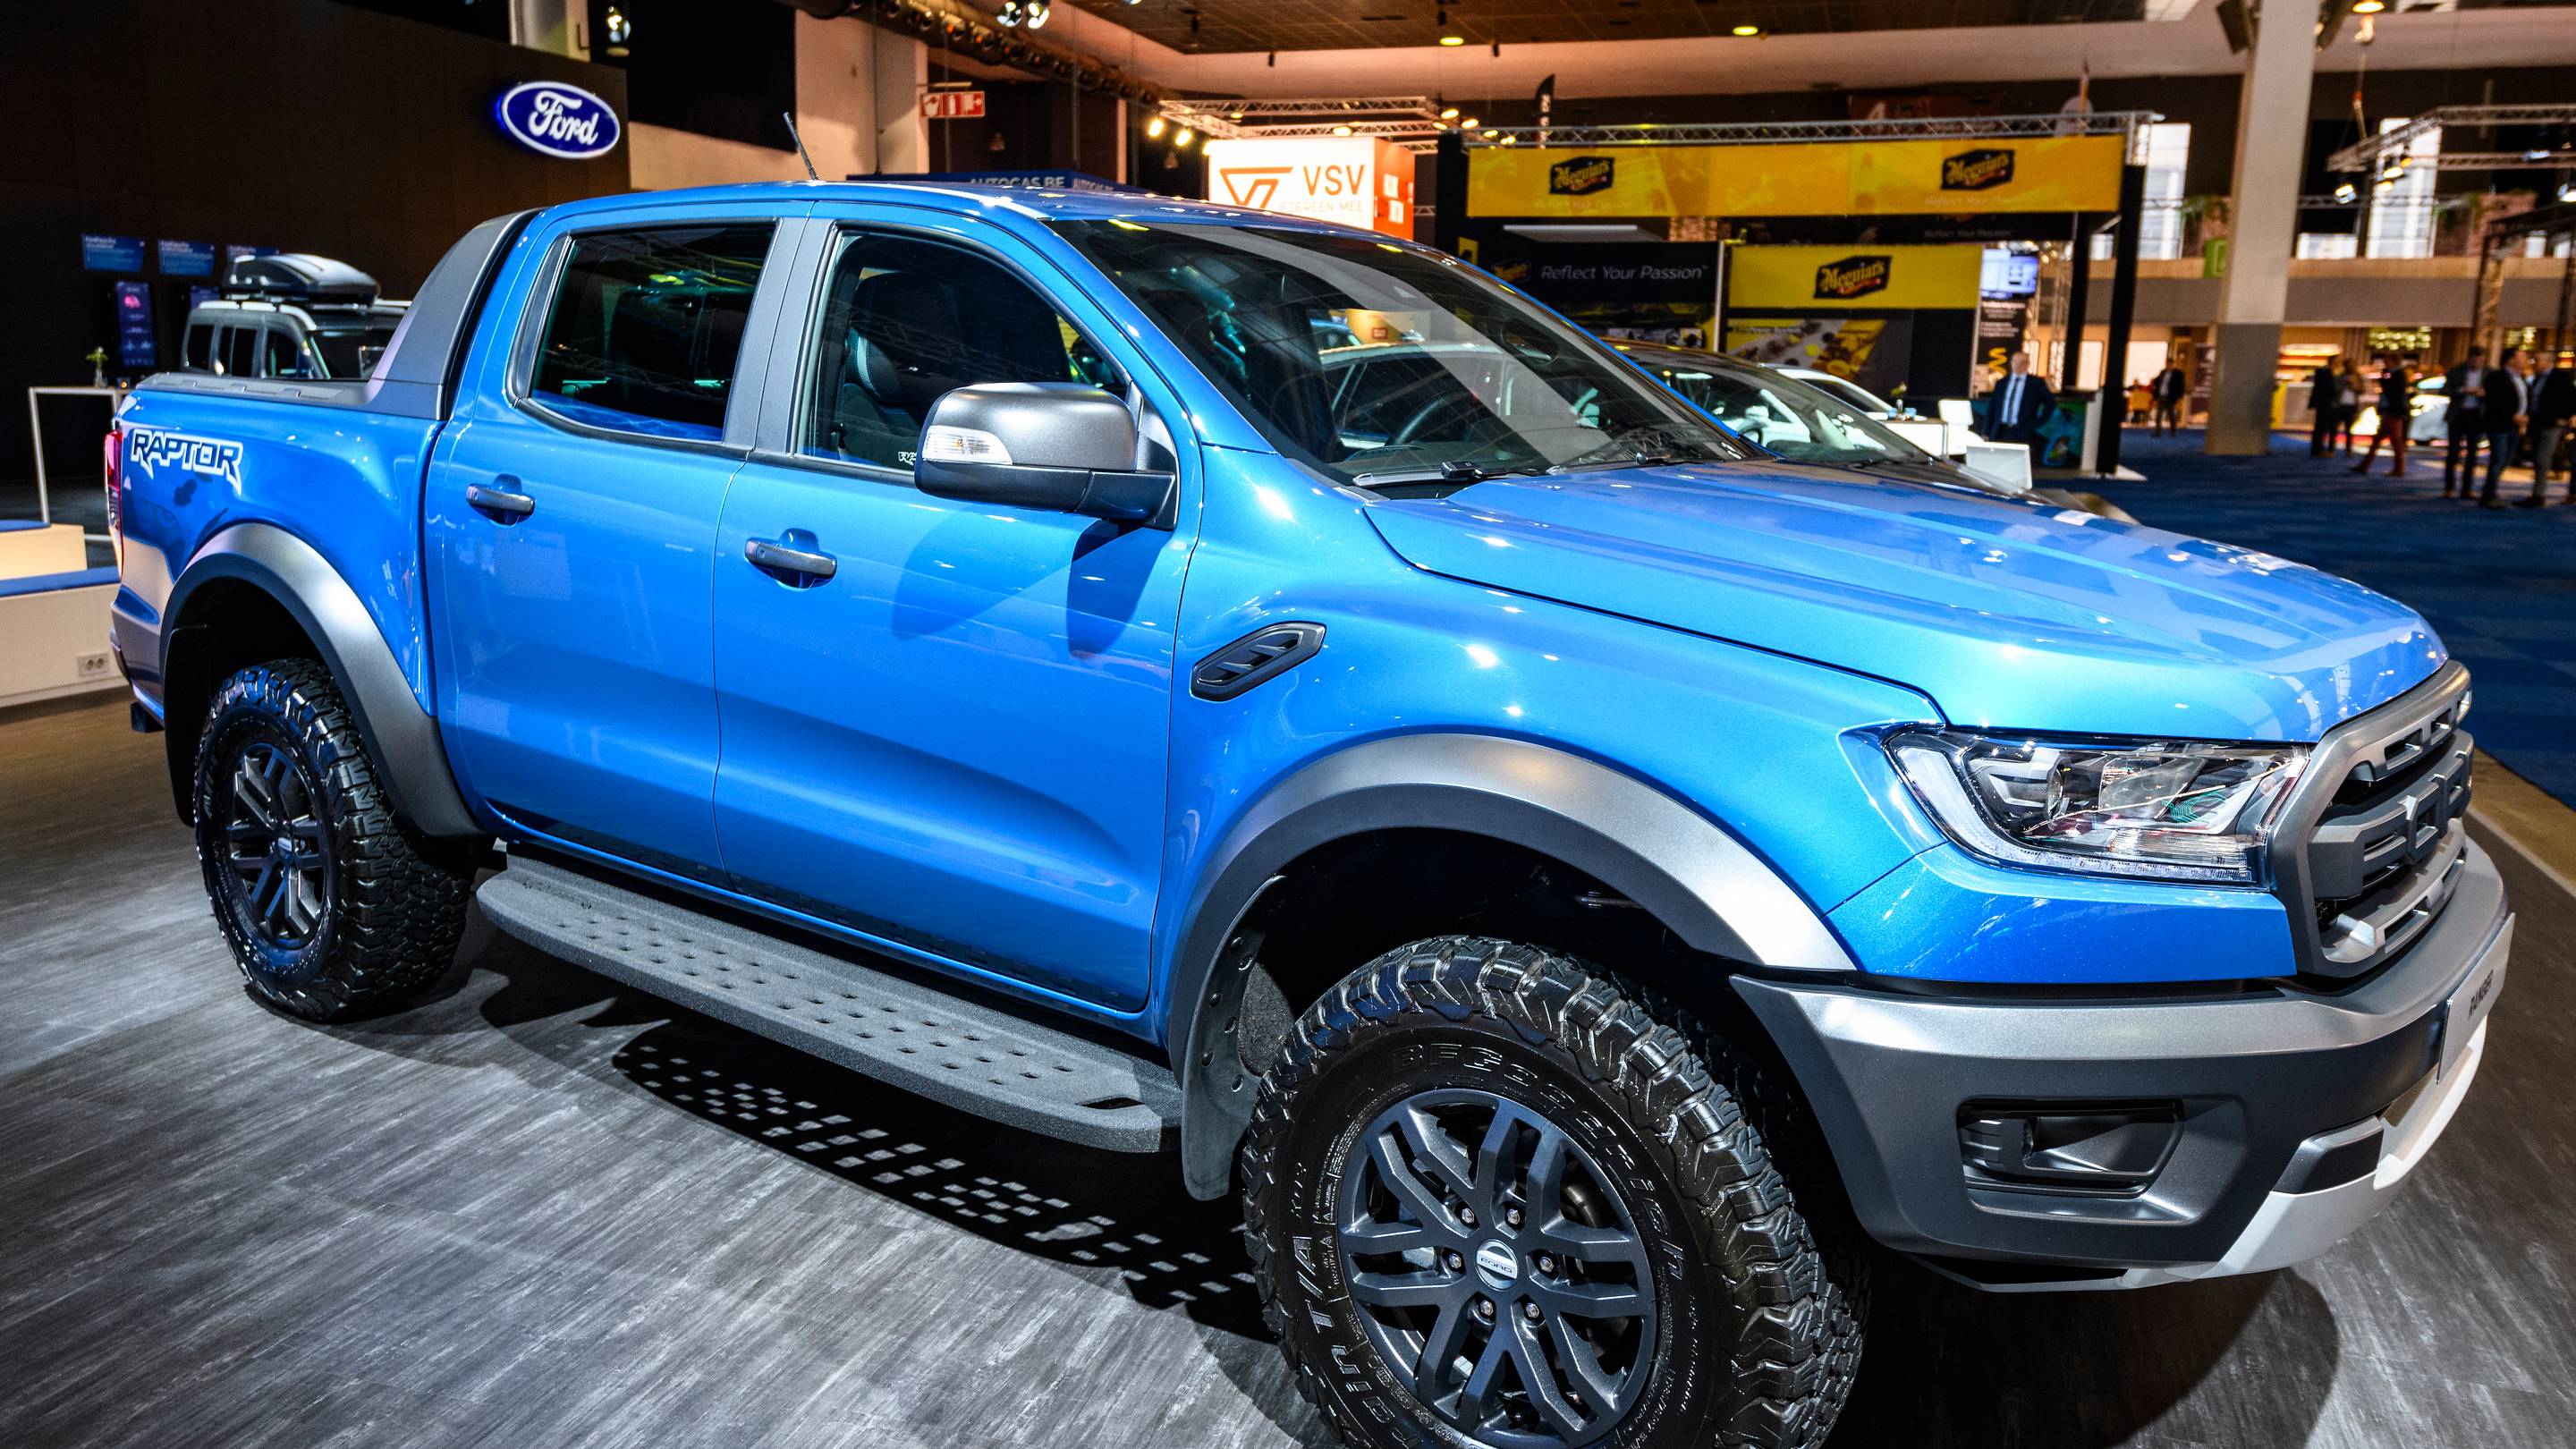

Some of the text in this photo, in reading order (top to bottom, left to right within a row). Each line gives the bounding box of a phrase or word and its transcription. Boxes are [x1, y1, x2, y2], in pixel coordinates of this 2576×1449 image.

[528, 90, 599, 146] Ford
[1303, 165, 1365, 196] VSV
[1539, 264, 1597, 281] Reflect
[1602, 265, 1637, 281] Your
[131, 428, 243, 496] RAPTOR
[1480, 1257, 1513, 1274] FORD
